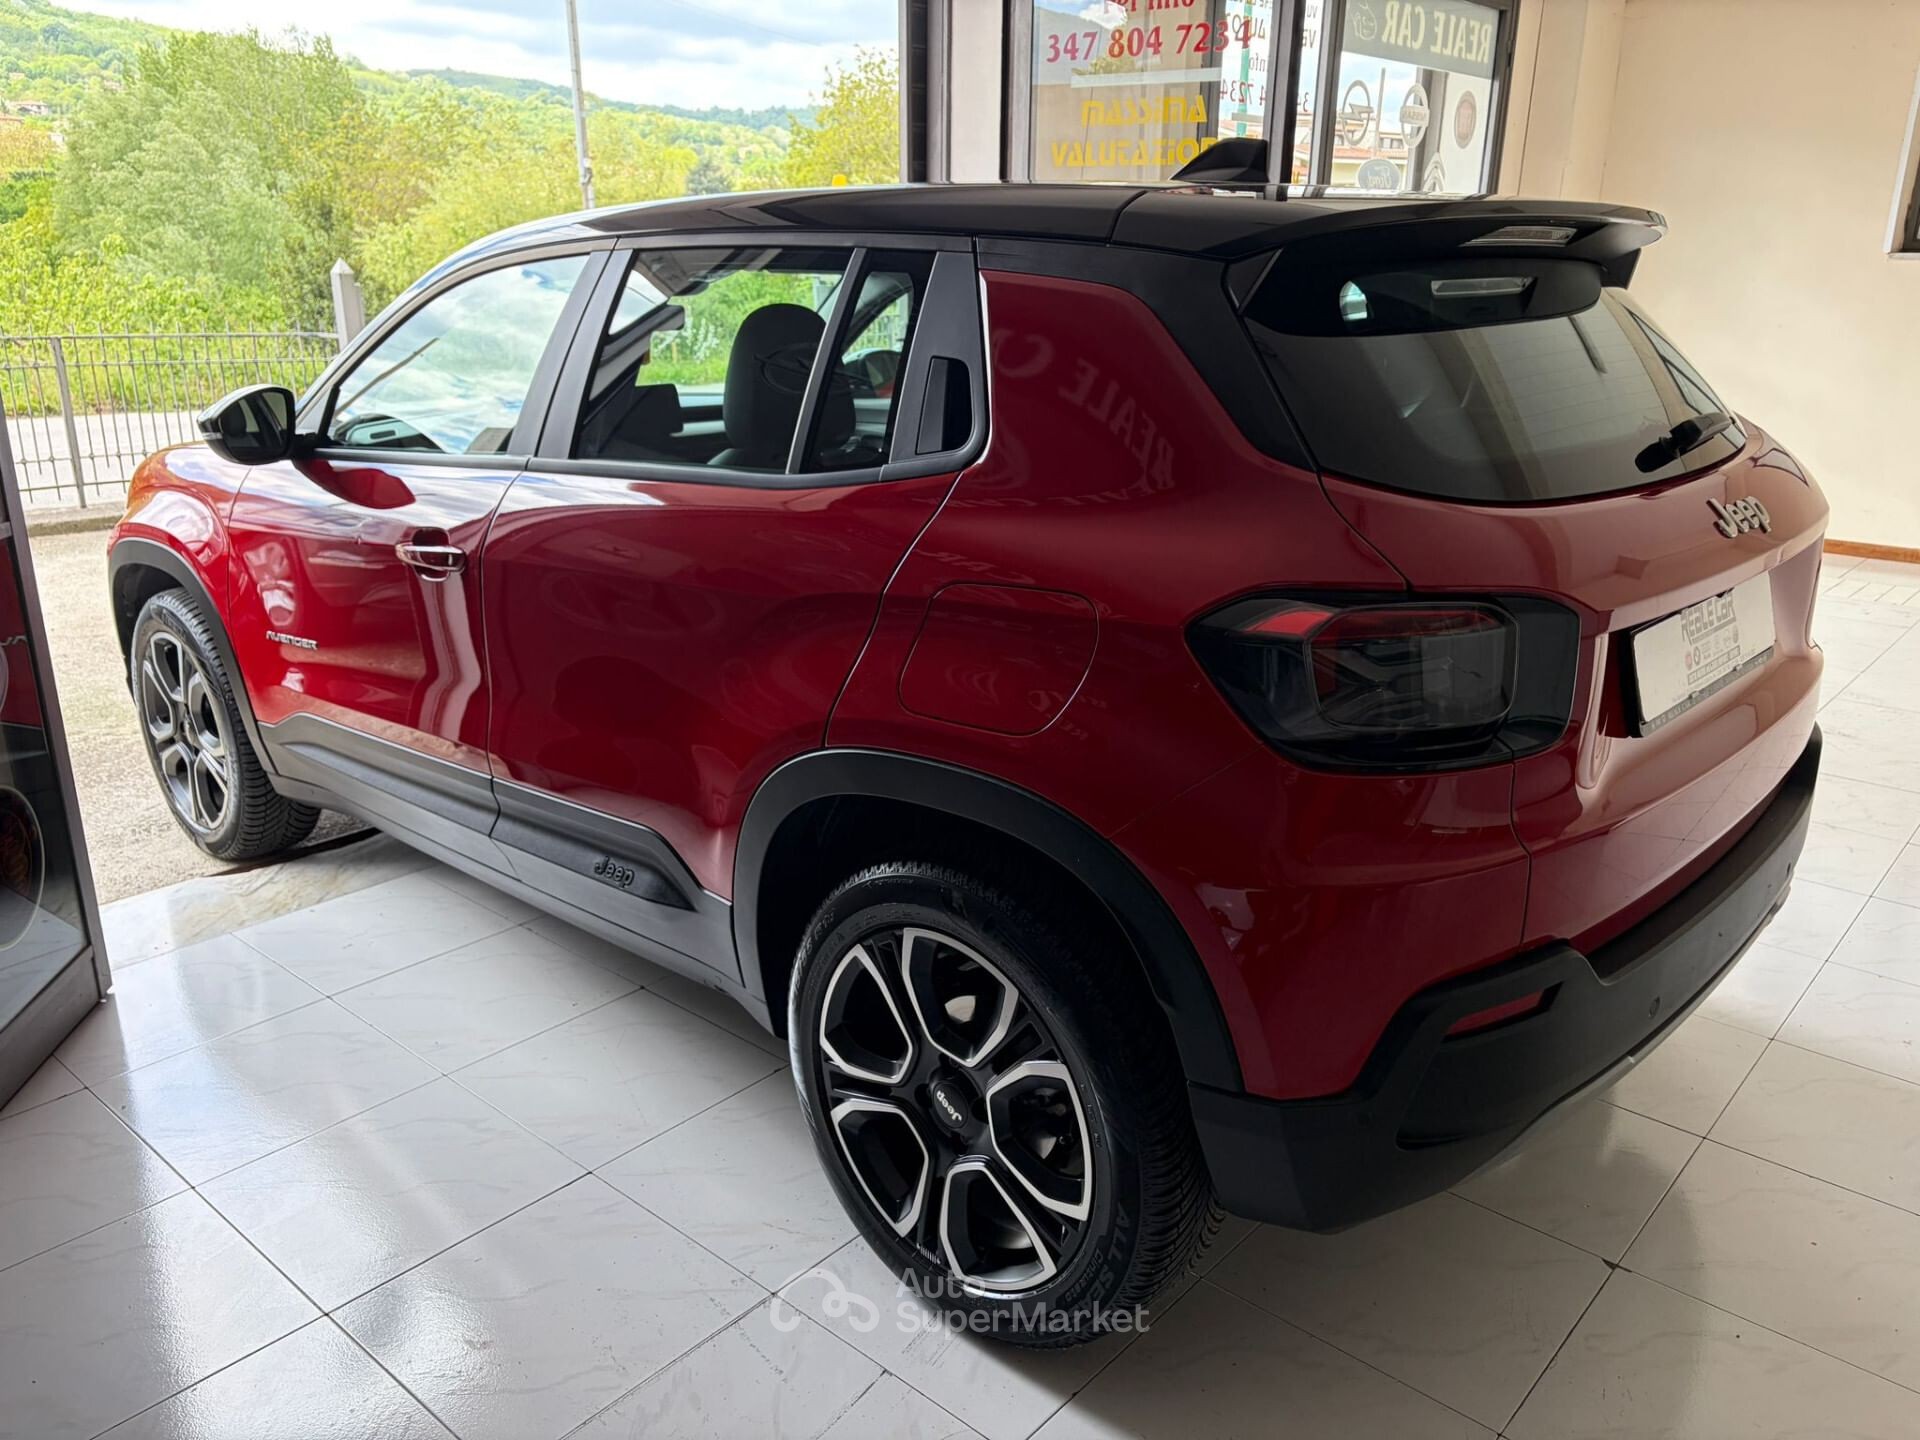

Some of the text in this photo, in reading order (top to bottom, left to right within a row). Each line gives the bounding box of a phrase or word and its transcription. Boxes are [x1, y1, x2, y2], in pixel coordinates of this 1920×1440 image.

[1046, 20, 1251, 63] 347 804 7234
[1707, 495, 1772, 539] Jeep
[266, 630, 318, 651] AVENGER
[594, 855, 635, 889] Jeep
[936, 1090, 963, 1122] Jeep
